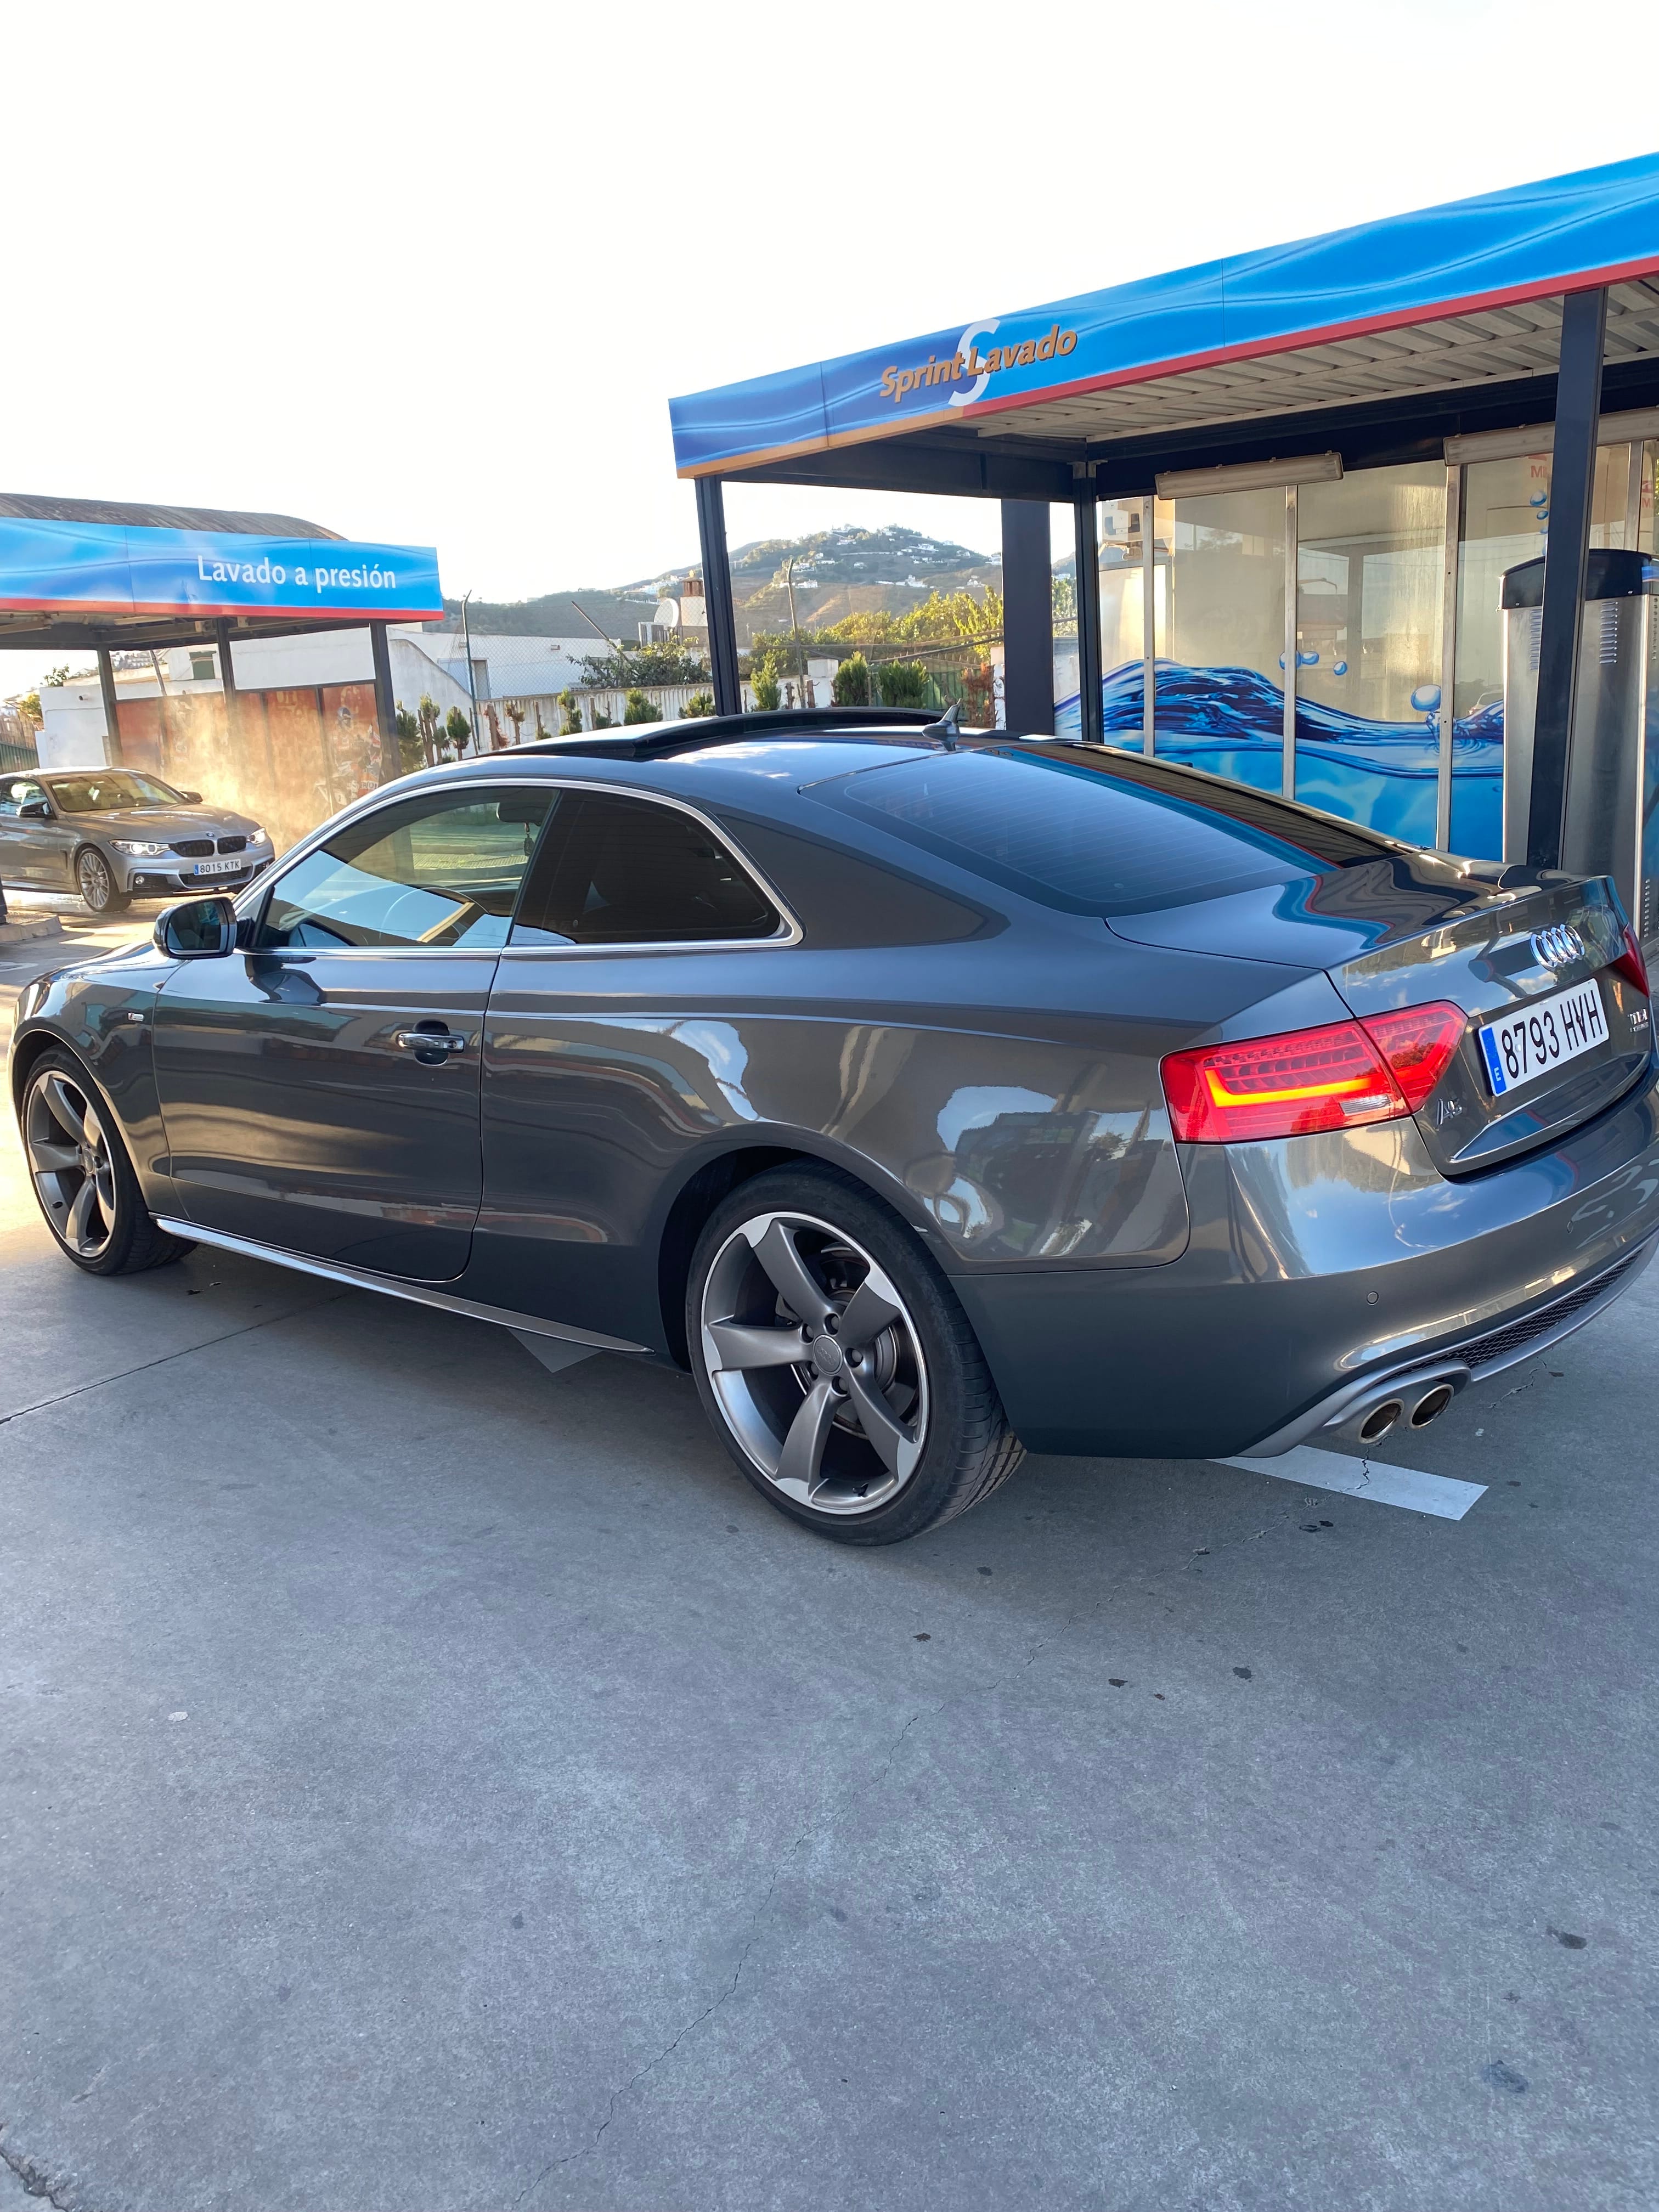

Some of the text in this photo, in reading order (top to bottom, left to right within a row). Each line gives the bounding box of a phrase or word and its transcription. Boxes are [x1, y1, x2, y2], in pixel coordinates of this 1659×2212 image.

[879, 324, 1077, 403] Sprint Lavado
[198, 555, 396, 594] Lavado a presión
[200, 860, 240, 873] 8015 KTK
[1494, 990, 1602, 1082] E 8793 HVH
